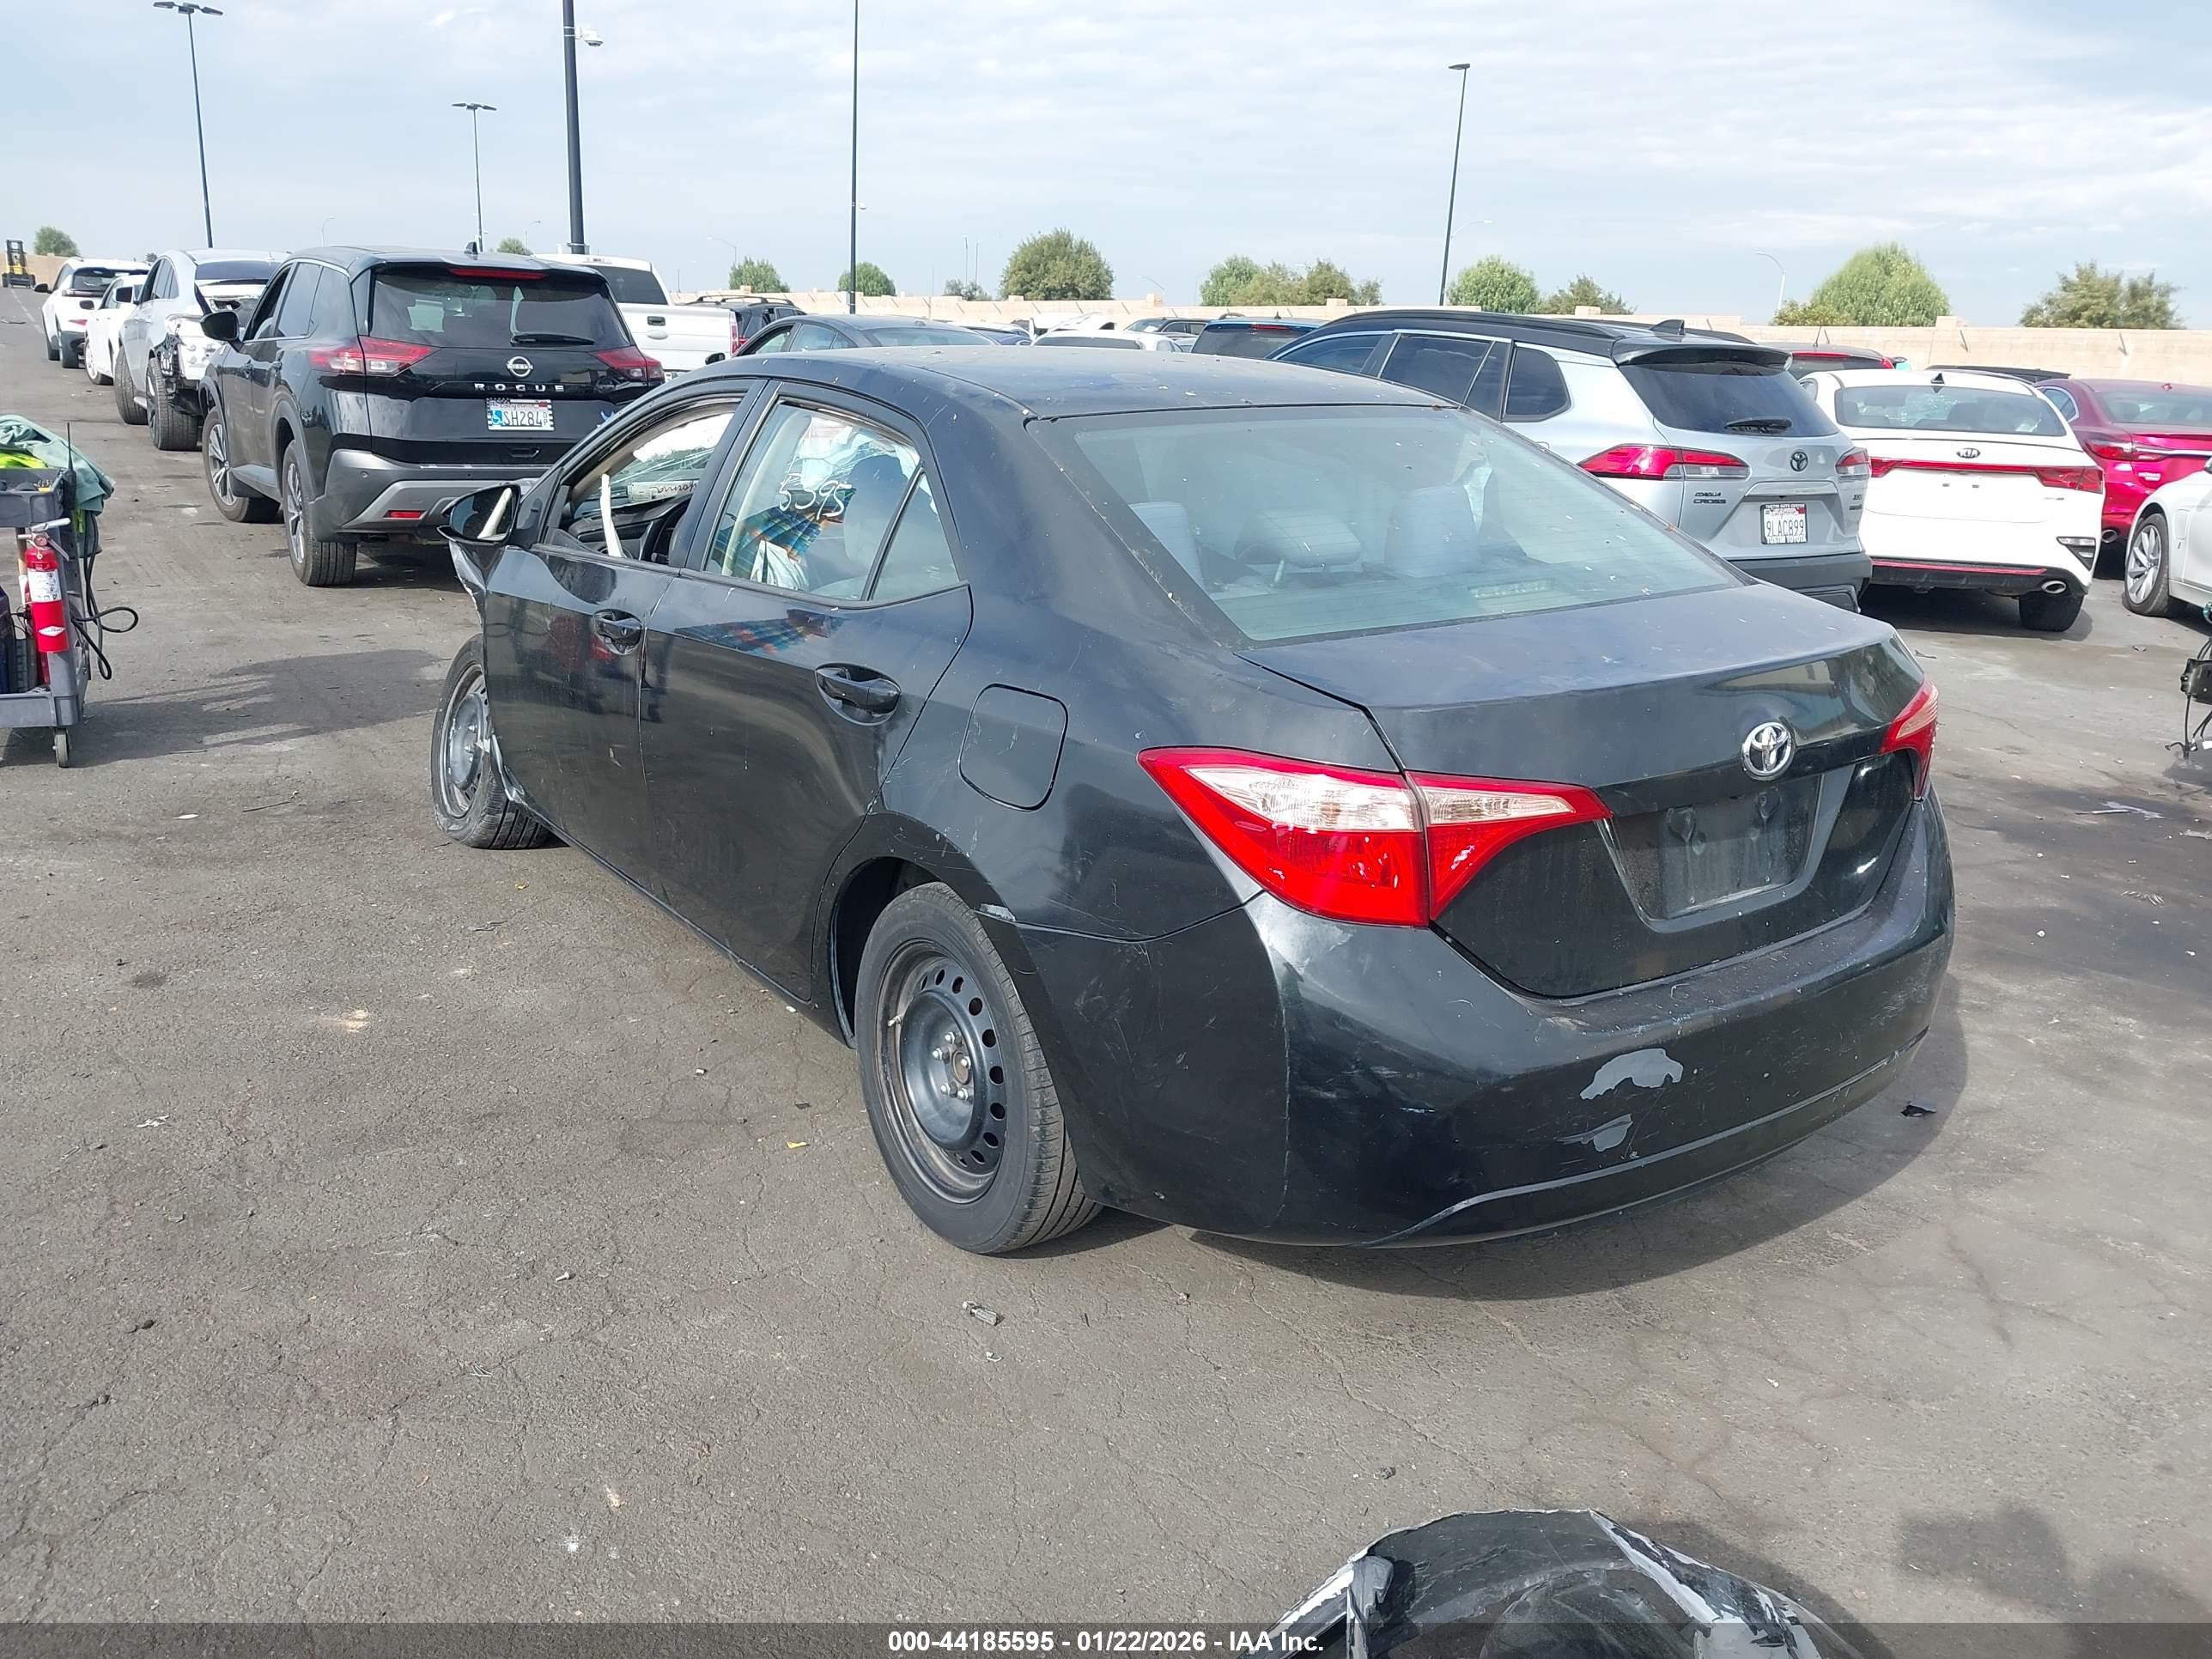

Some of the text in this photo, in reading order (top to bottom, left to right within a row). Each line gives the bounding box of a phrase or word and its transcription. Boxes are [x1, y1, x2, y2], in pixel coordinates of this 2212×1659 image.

[474, 383, 565, 392] ROGUE
[1957, 447, 1980, 459] KIA
[1766, 520, 1805, 537] 9LAC899
